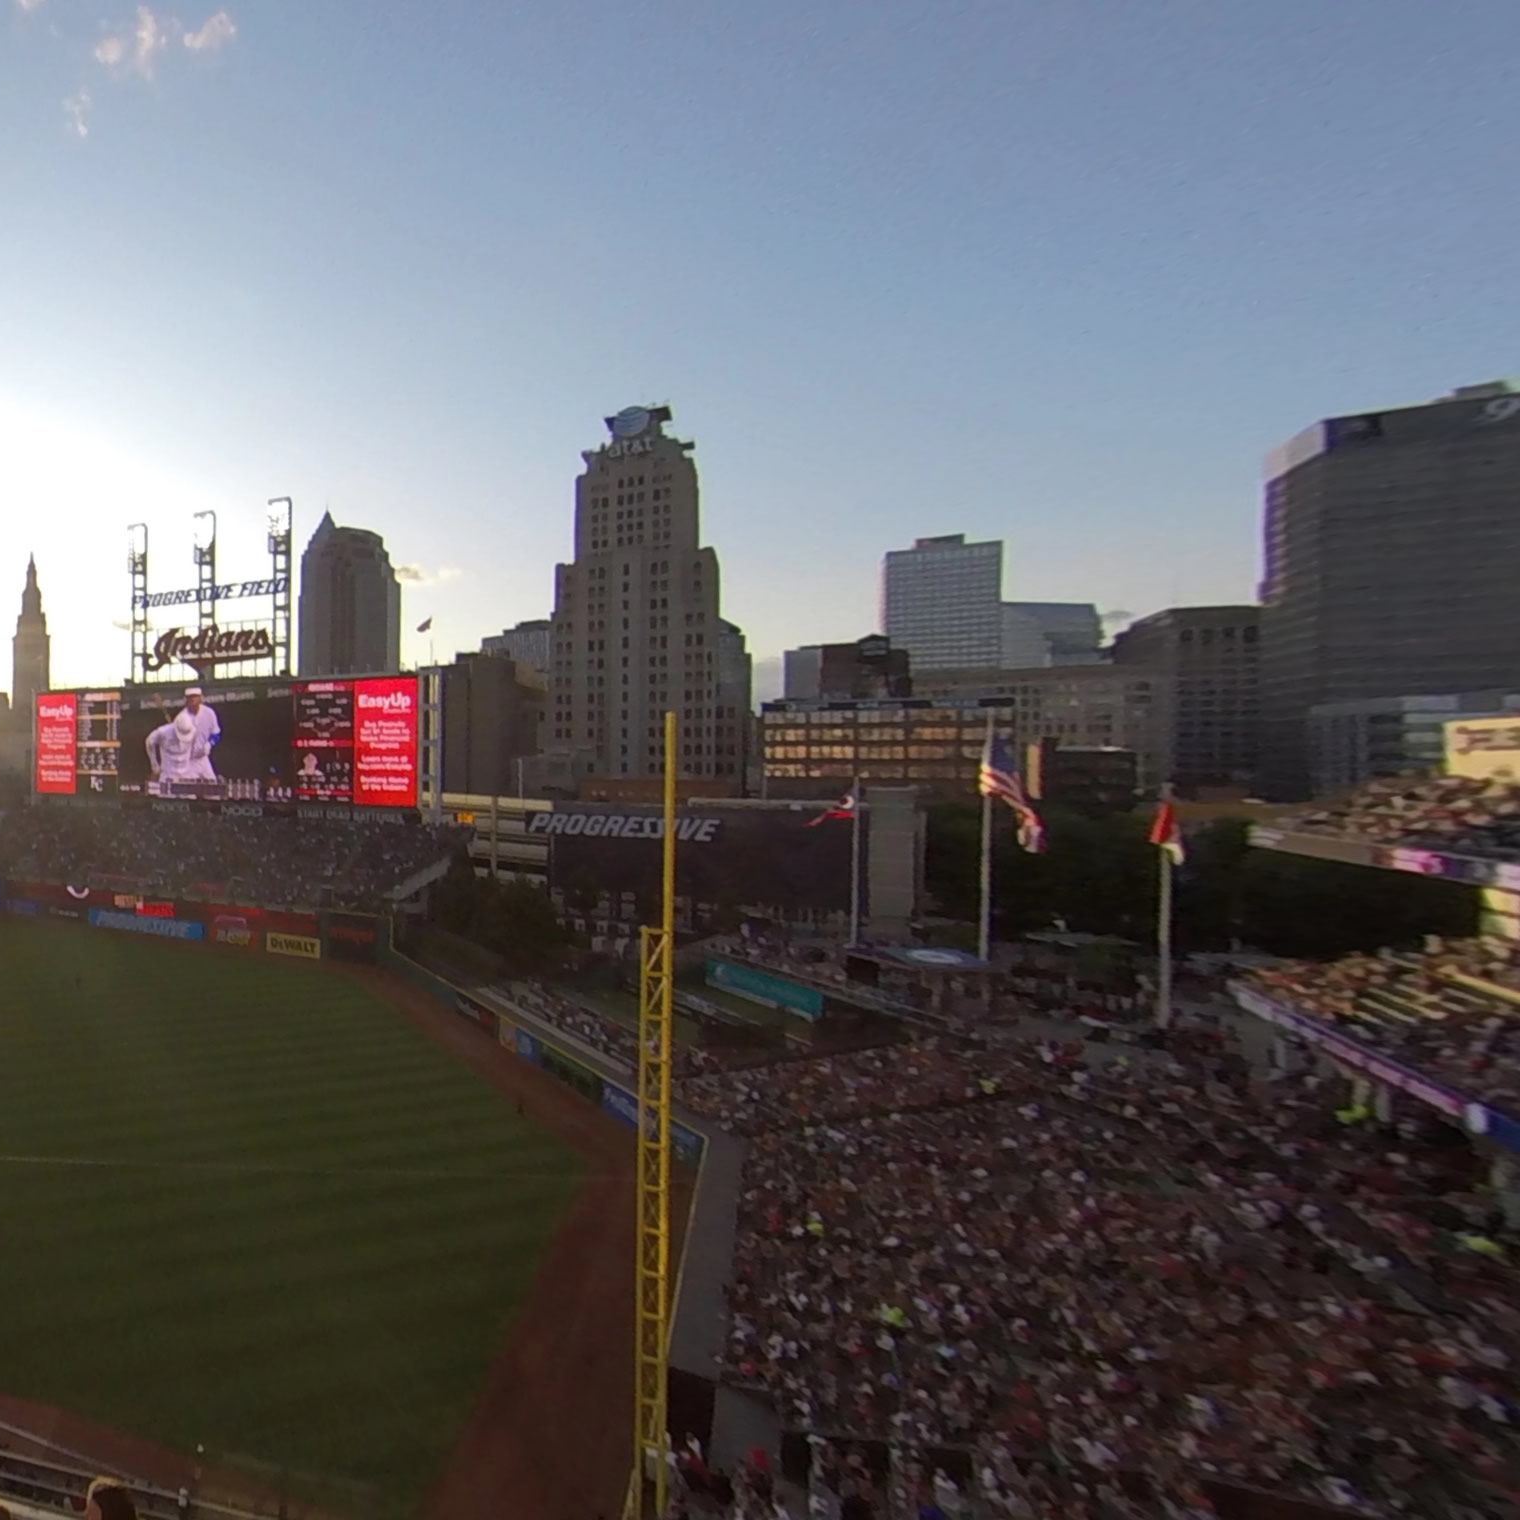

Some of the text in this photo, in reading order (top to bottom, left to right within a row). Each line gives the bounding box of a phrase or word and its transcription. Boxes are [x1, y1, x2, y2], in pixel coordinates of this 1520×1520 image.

[132, 576, 290, 610] PROGRESSIVE FIELD
[143, 624, 275, 672] Indians
[357, 691, 412, 710] EasyUp
[529, 813, 721, 843] PROGRESSVE
